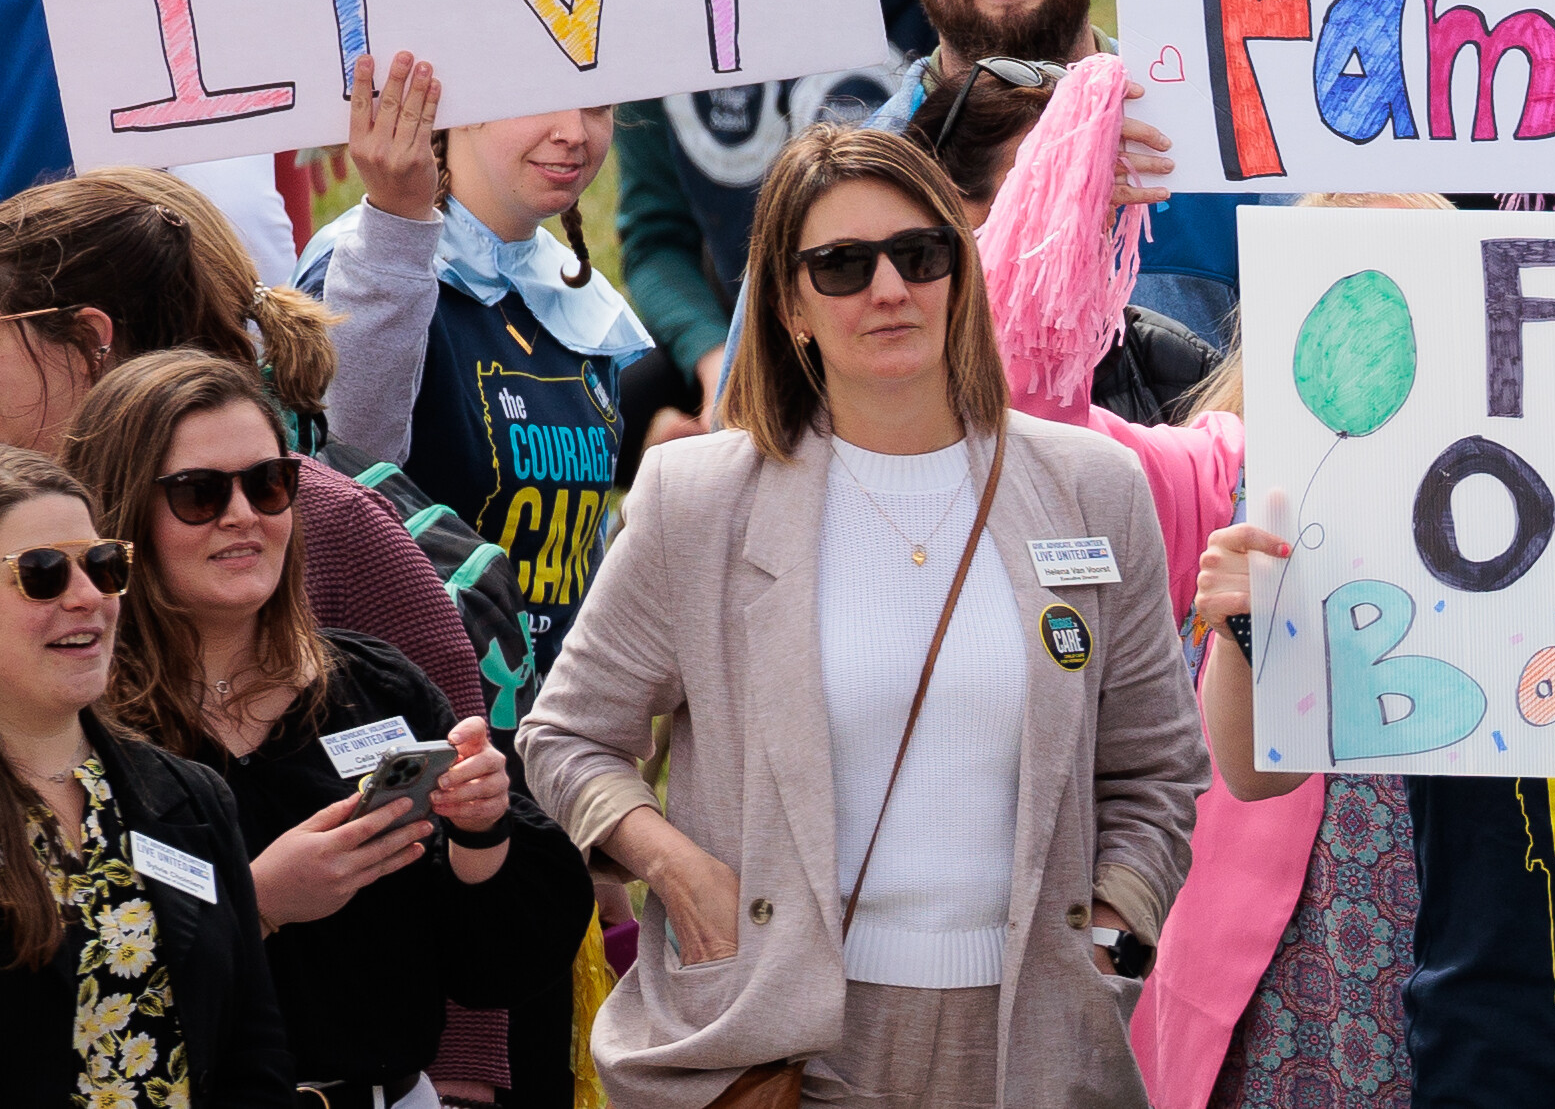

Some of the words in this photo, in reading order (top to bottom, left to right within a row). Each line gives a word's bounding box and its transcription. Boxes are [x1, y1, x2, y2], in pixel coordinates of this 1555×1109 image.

[499, 388, 527, 420] the
[509, 423, 610, 482] COURAGE
[499, 486, 610, 605] CAR
[1035, 550, 1055, 562] LIVE
[1055, 549, 1088, 561] UNITED
[1052, 629, 1085, 653] CARE
[329, 742, 351, 756] LIVE
[351, 733, 385, 750] UNITED
